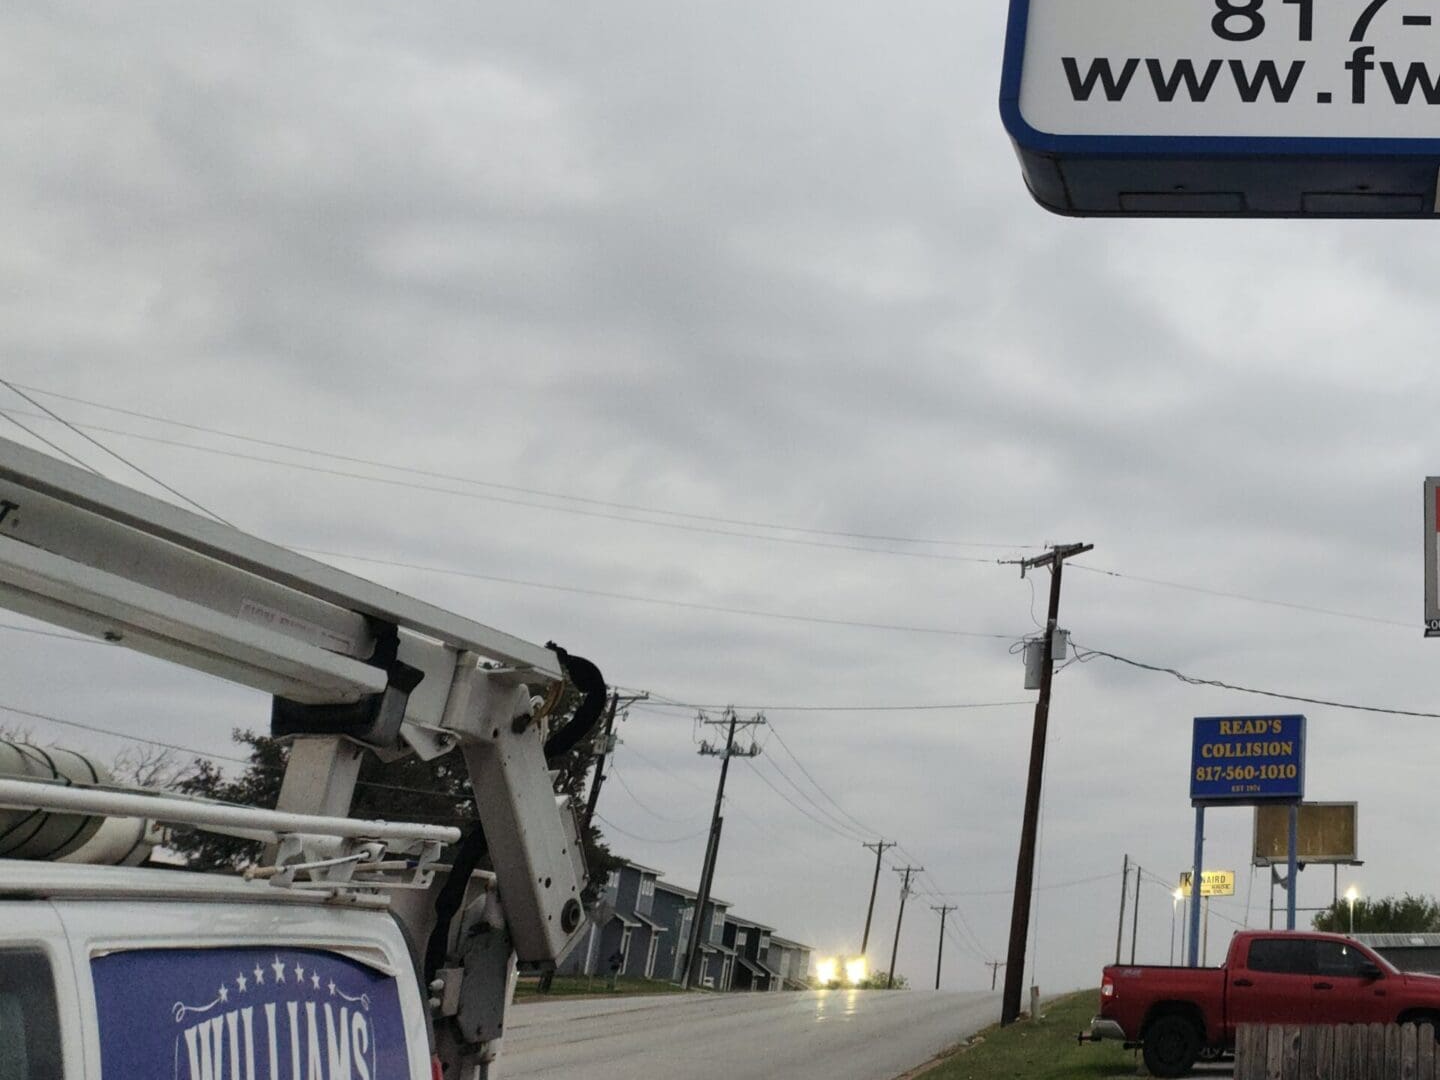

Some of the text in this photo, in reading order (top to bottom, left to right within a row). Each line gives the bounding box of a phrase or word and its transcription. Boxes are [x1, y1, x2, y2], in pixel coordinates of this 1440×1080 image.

[1220, 719, 1282, 735] READ'S
[1202, 742, 1293, 758] COLLISION
[1196, 764, 1297, 781] 817-560-1010
